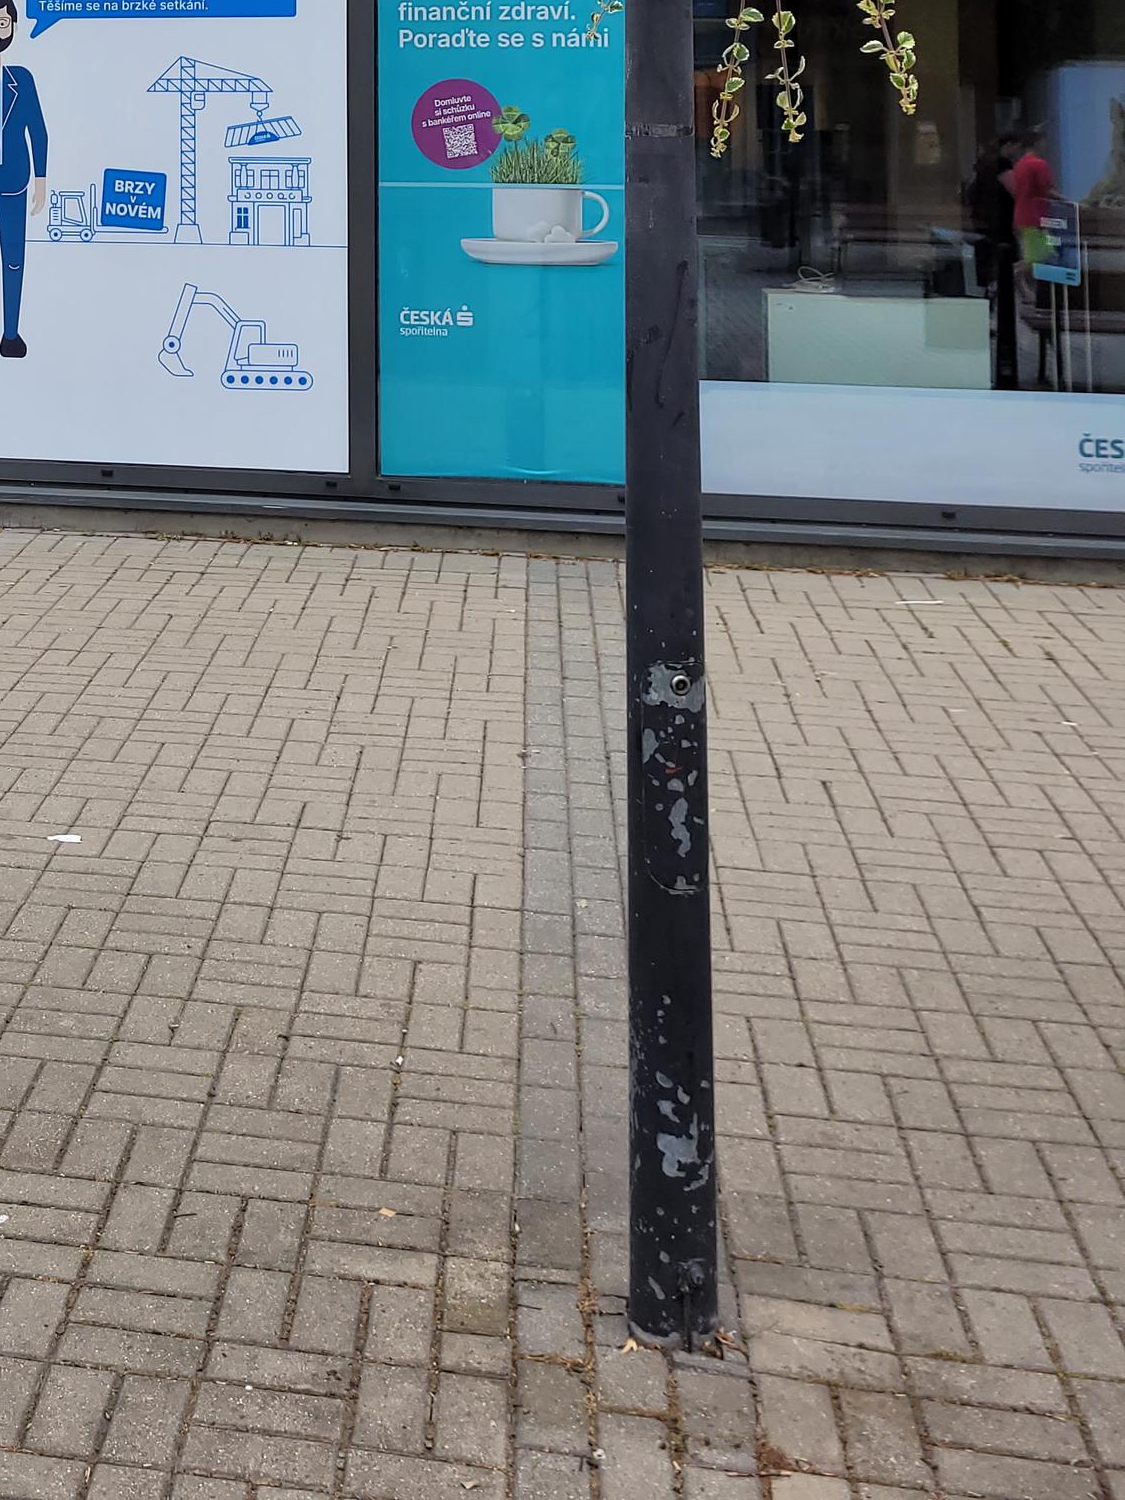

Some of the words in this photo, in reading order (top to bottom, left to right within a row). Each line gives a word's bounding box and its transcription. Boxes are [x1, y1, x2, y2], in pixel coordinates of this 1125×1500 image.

[38, 0, 83, 12] Těšíme
[85, 2, 99, 11] se
[103, 2, 118, 11] na
[121, 0, 157, 11] brzké
[398, 1, 492, 21] finanční
[498, 1, 576, 20] zdraví.
[399, 28, 491, 49] Poraďte
[497, 32, 525, 48] se
[531, 32, 546, 48] s
[551, 28, 610, 48] námi
[434, 95, 472, 107] Domluvte
[443, 103, 475, 115] schůzku
[428, 115, 467, 127] bankéřem
[467, 110, 492, 120] online
[114, 179, 155, 194] BRZY
[105, 202, 161, 219] NOVÉM
[400, 307, 453, 326] ČESKÁ
[399, 326, 448, 336] spořitelna
